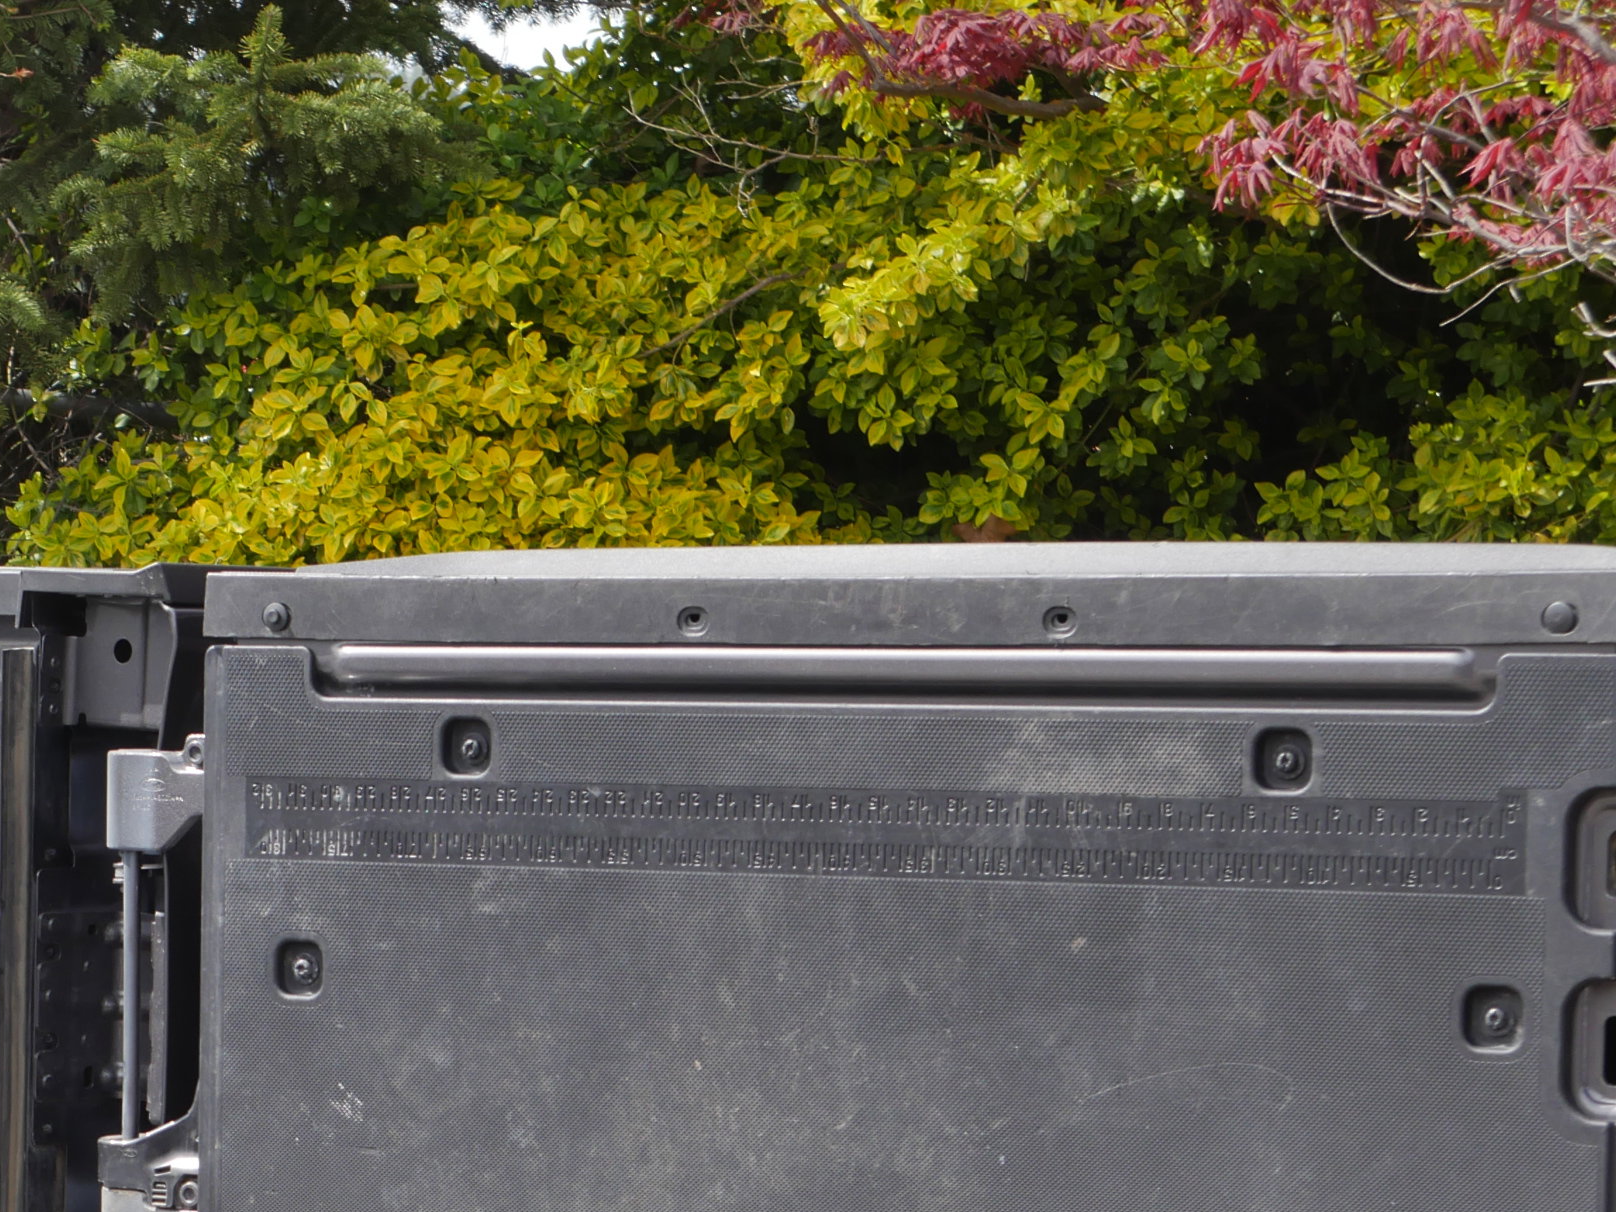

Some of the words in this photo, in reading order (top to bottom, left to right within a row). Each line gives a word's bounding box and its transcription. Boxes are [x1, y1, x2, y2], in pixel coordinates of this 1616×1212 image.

[252, 784, 273, 796] 32
[288, 783, 307, 797] 31
[355, 785, 376, 799] 29
[391, 786, 411, 799] 28
[425, 786, 446, 800] 27
[460, 787, 481, 800] 26
[497, 788, 518, 802] 25
[533, 789, 553, 803] 24
[569, 790, 589, 803] 23
[604, 791, 626, 805] 22
[644, 791, 663, 805] 21
[679, 792, 701, 806] 20
[716, 793, 735, 807] 19
[753, 794, 773, 807] 18
[791, 795, 812, 808] 17
[829, 795, 850, 809] 16
[869, 796, 888, 810] 15
[907, 797, 928, 811] 14
[947, 798, 968, 812] 13
[985, 799, 1007, 812] 12
[1028, 800, 1048, 813] 11
[1066, 800, 1088, 814] 10
[1122, 802, 1133, 815] 9
[1164, 803, 1173, 816] 8
[1204, 803, 1216, 817] 7
[1246, 805, 1256, 819] 6
[1289, 805, 1300, 819] 5
[1332, 807, 1343, 820] 4
[1375, 807, 1385, 822] 3
[1416, 808, 1429, 822] 2
[1460, 809, 1470, 823] 1
[1506, 810, 1516, 825] 0
[1493, 849, 1518, 860] cm
